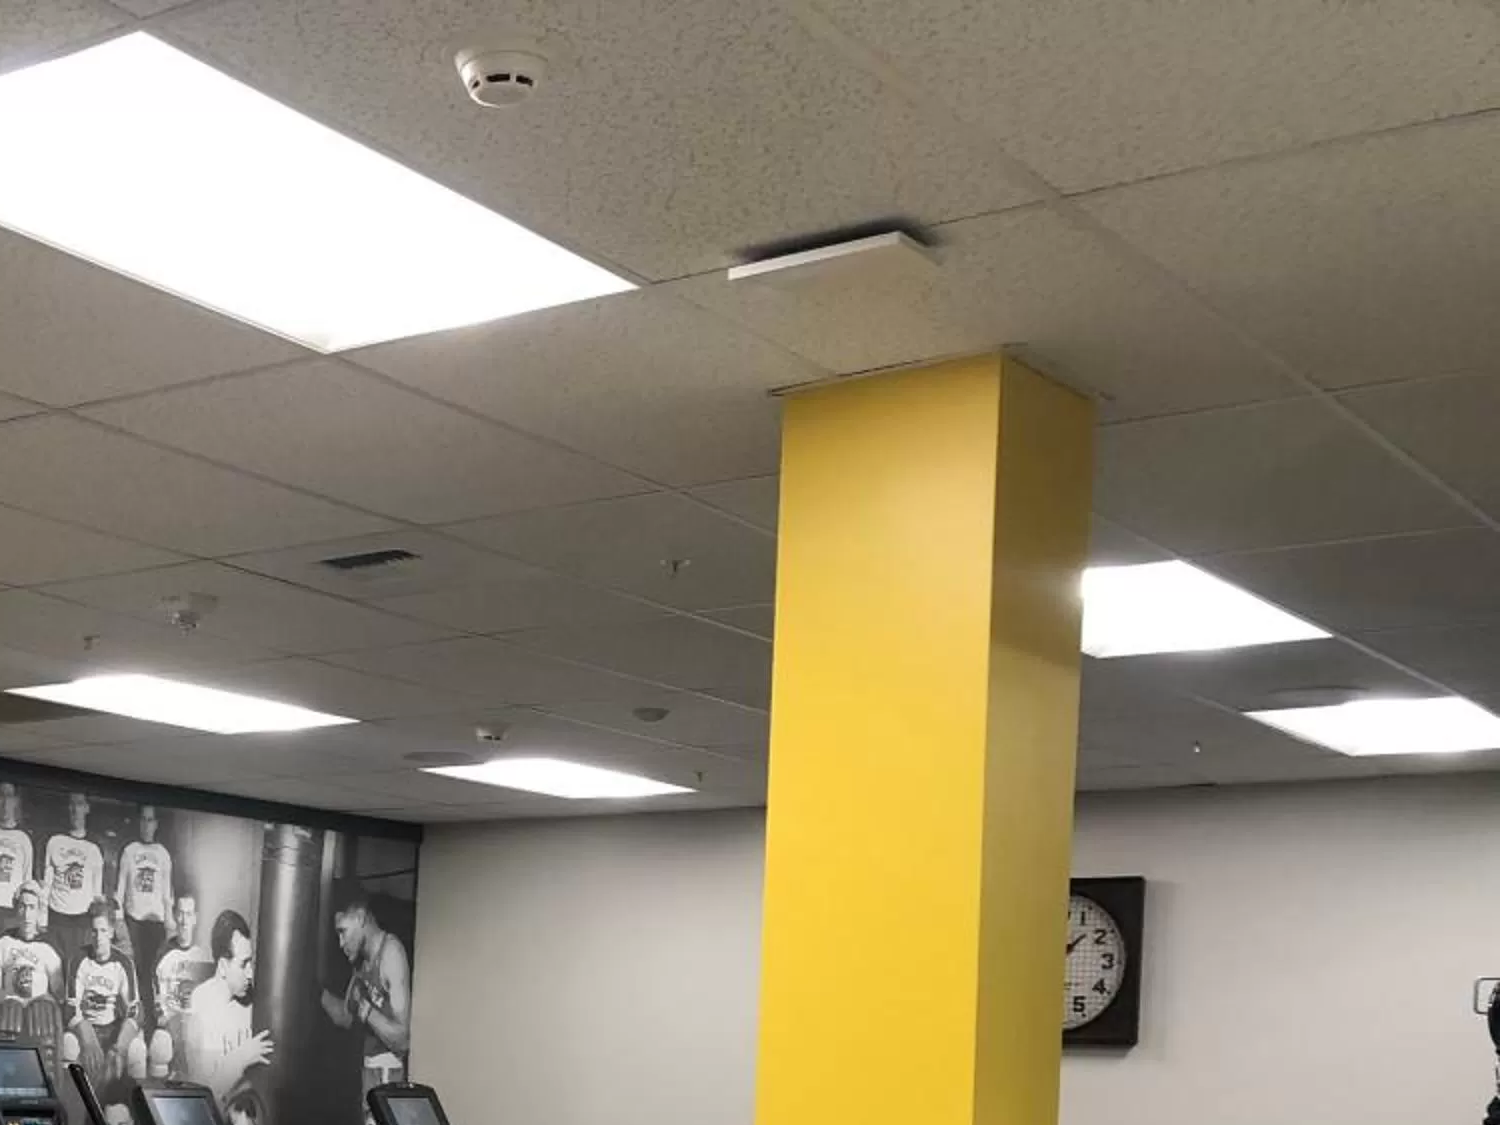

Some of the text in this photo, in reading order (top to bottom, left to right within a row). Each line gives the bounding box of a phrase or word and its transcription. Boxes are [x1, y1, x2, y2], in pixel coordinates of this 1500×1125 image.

[1093, 929, 1107, 945] 2
[1101, 952, 1115, 970] 3
[1092, 978, 1107, 995] 4
[1073, 995, 1087, 1012] 5
